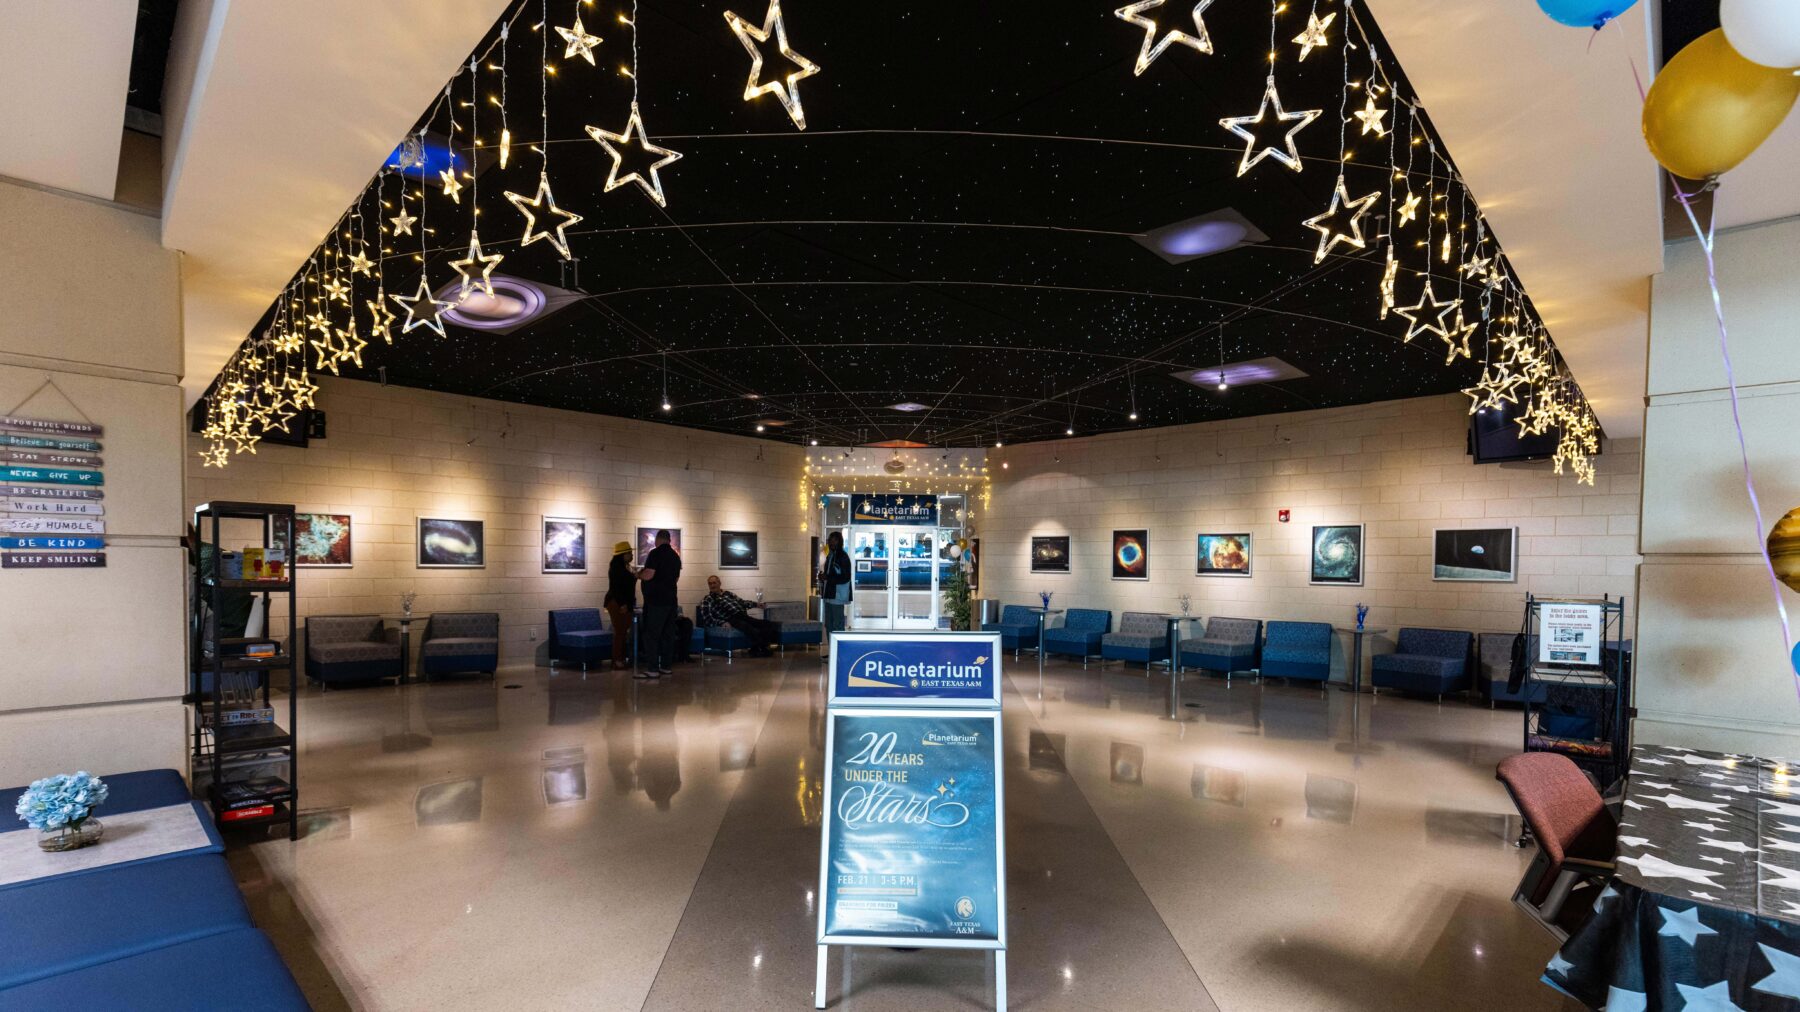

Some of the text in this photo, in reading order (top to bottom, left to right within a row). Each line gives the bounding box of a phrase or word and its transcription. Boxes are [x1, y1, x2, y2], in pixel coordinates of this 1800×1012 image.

[13, 419, 60, 429] POWERFUL
[63, 423, 92, 431] WORDS
[10, 437, 40, 446] Believe
[58, 441, 90, 450] yourself
[32, 489, 89, 497] GRATEFUL
[14, 502, 86, 512] Work Hard
[11, 520, 94, 530] Stay HUMBLE
[865, 661, 982, 679] Planetarium
[928, 733, 977, 742] Planetarium
[846, 731, 924, 766] 20 YEARS
[845, 770, 907, 783] UNDER THE
[838, 782, 969, 830] Stars
[838, 875, 856, 884] FEB.
[858, 876, 868, 884] 21
